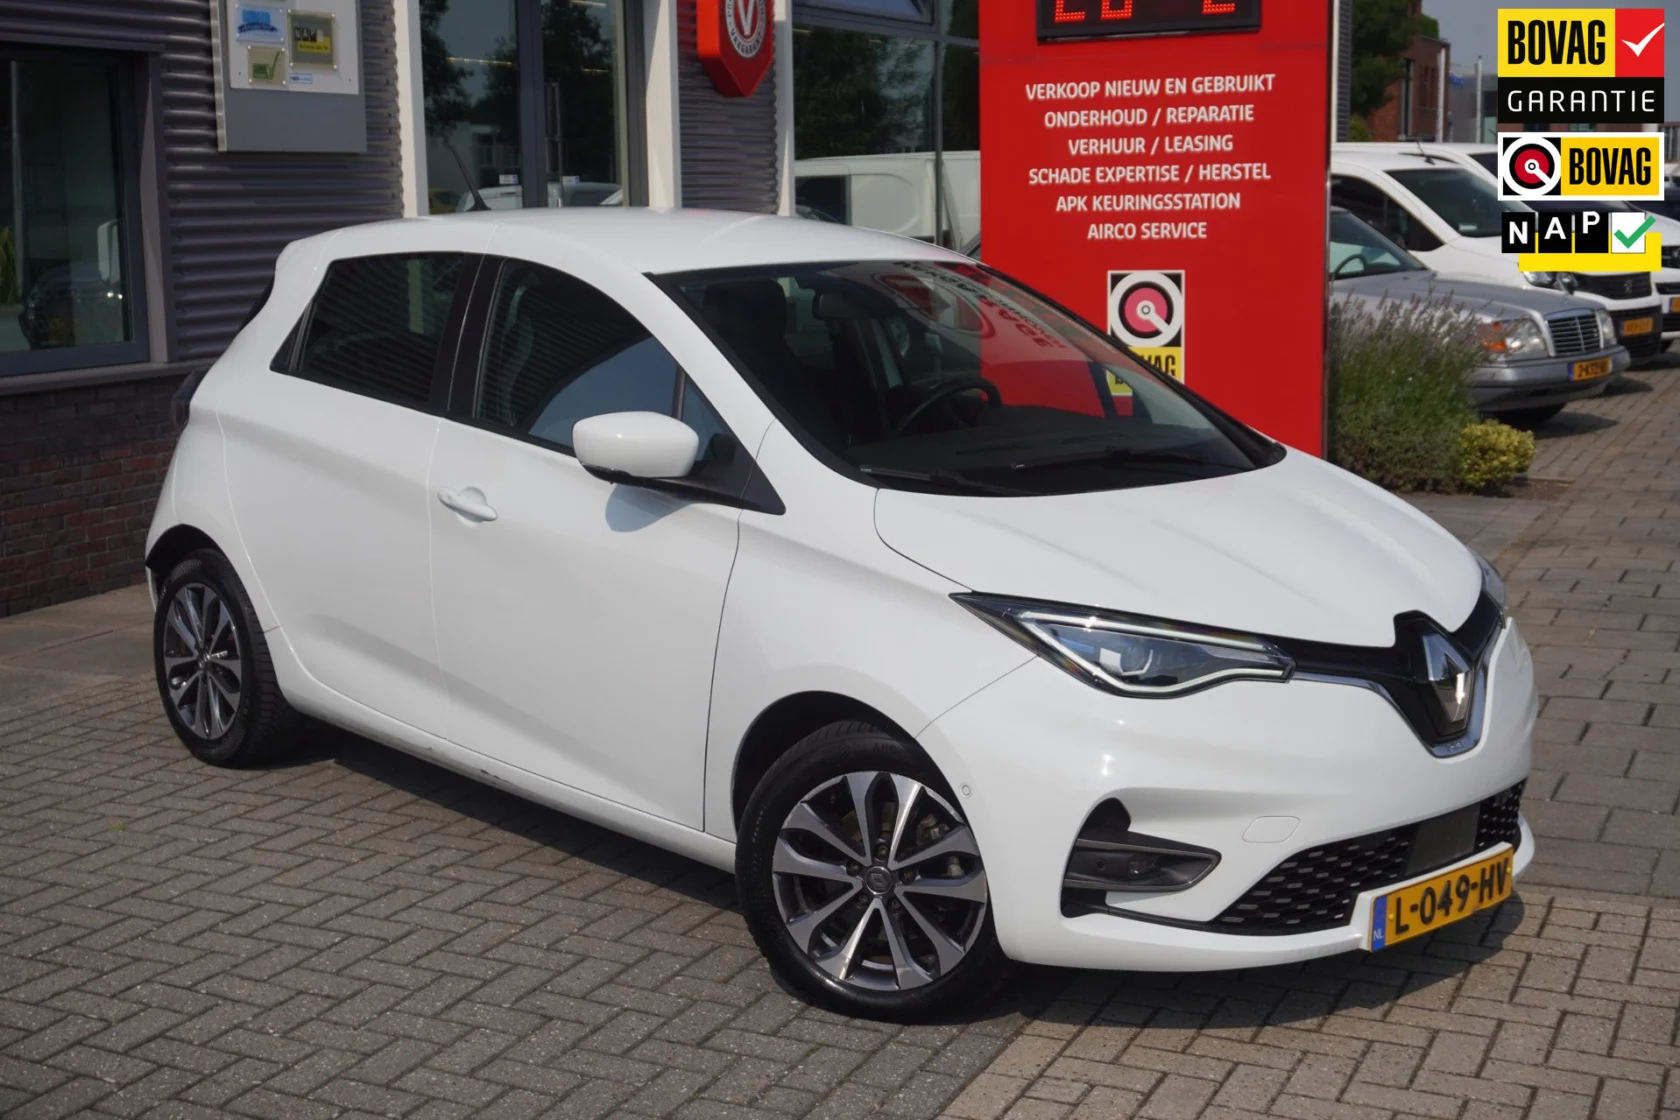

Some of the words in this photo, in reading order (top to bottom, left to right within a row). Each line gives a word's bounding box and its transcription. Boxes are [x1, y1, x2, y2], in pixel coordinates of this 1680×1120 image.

[1026, 82, 1100, 100] VERKOOP
[1105, 79, 1160, 96] NIEUW
[1165, 78, 1186, 95] EN
[1192, 74, 1275, 94] GEBRUIKT
[1045, 108, 1147, 128] ONDERHOUD
[1152, 108, 1161, 126] /
[1166, 105, 1254, 123] REPARATIE
[1068, 137, 1145, 155] VERHUUR
[1150, 137, 1159, 155] /
[1165, 134, 1233, 153] LEASING
[1029, 167, 1091, 185] SCHADE
[1096, 165, 1179, 183] EXPERTISE
[1184, 165, 1194, 183] /
[1199, 163, 1271, 181] HERSTEL
[1056, 196, 1087, 211] APK
[1093, 193, 1240, 211] KEURINGSSTATION
[1088, 223, 1136, 239] AIRCO
[1141, 222, 1207, 239] SERVICE
[1395, 857, 1509, 935] L-049-HV
[1373, 928, 1383, 941] NL
